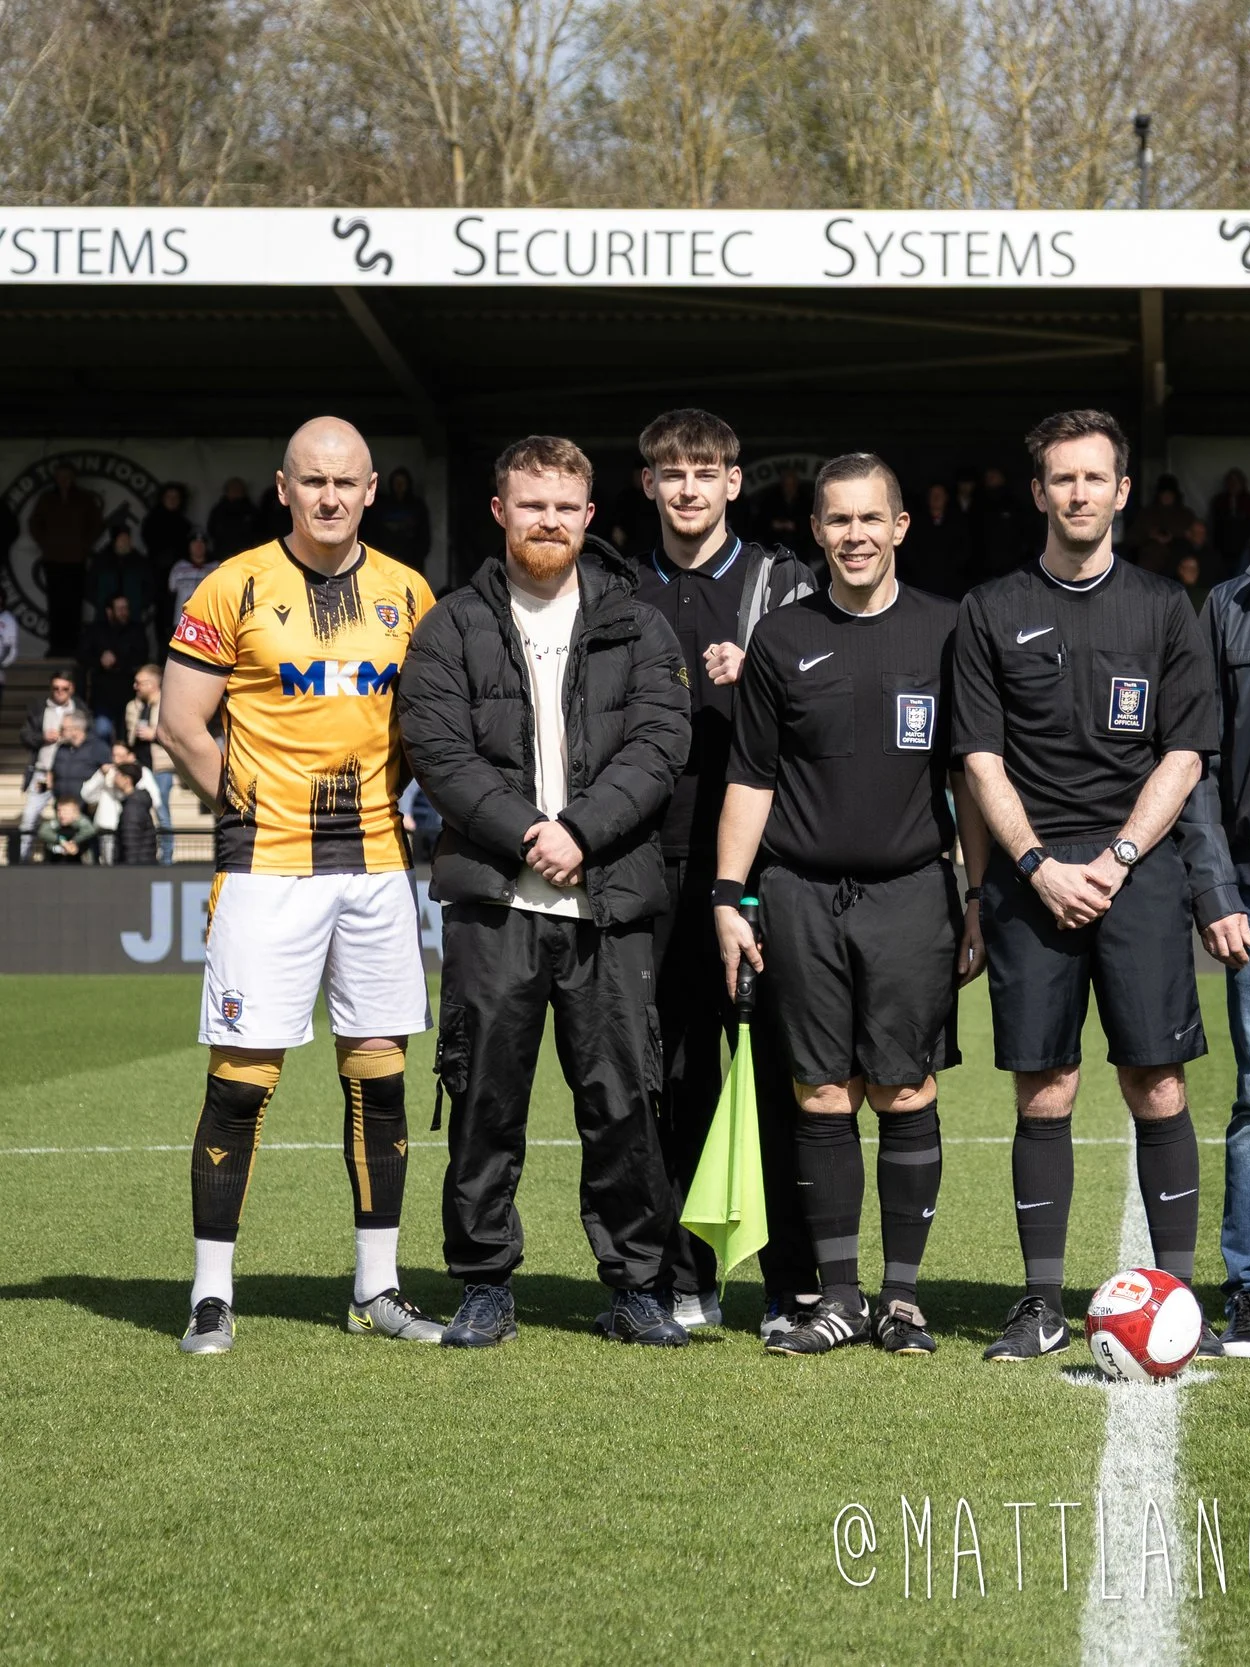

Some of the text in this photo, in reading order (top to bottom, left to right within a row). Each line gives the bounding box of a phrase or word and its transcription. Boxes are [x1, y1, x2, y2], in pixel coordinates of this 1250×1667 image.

[0, 227, 190, 276] STEMS
[453, 216, 1076, 278] SECURITEC SYSTEMS
[543, 645, 569, 655] JEA
[278, 660, 398, 697] MKM
[1114, 719, 1140, 727] OFFICIAL
